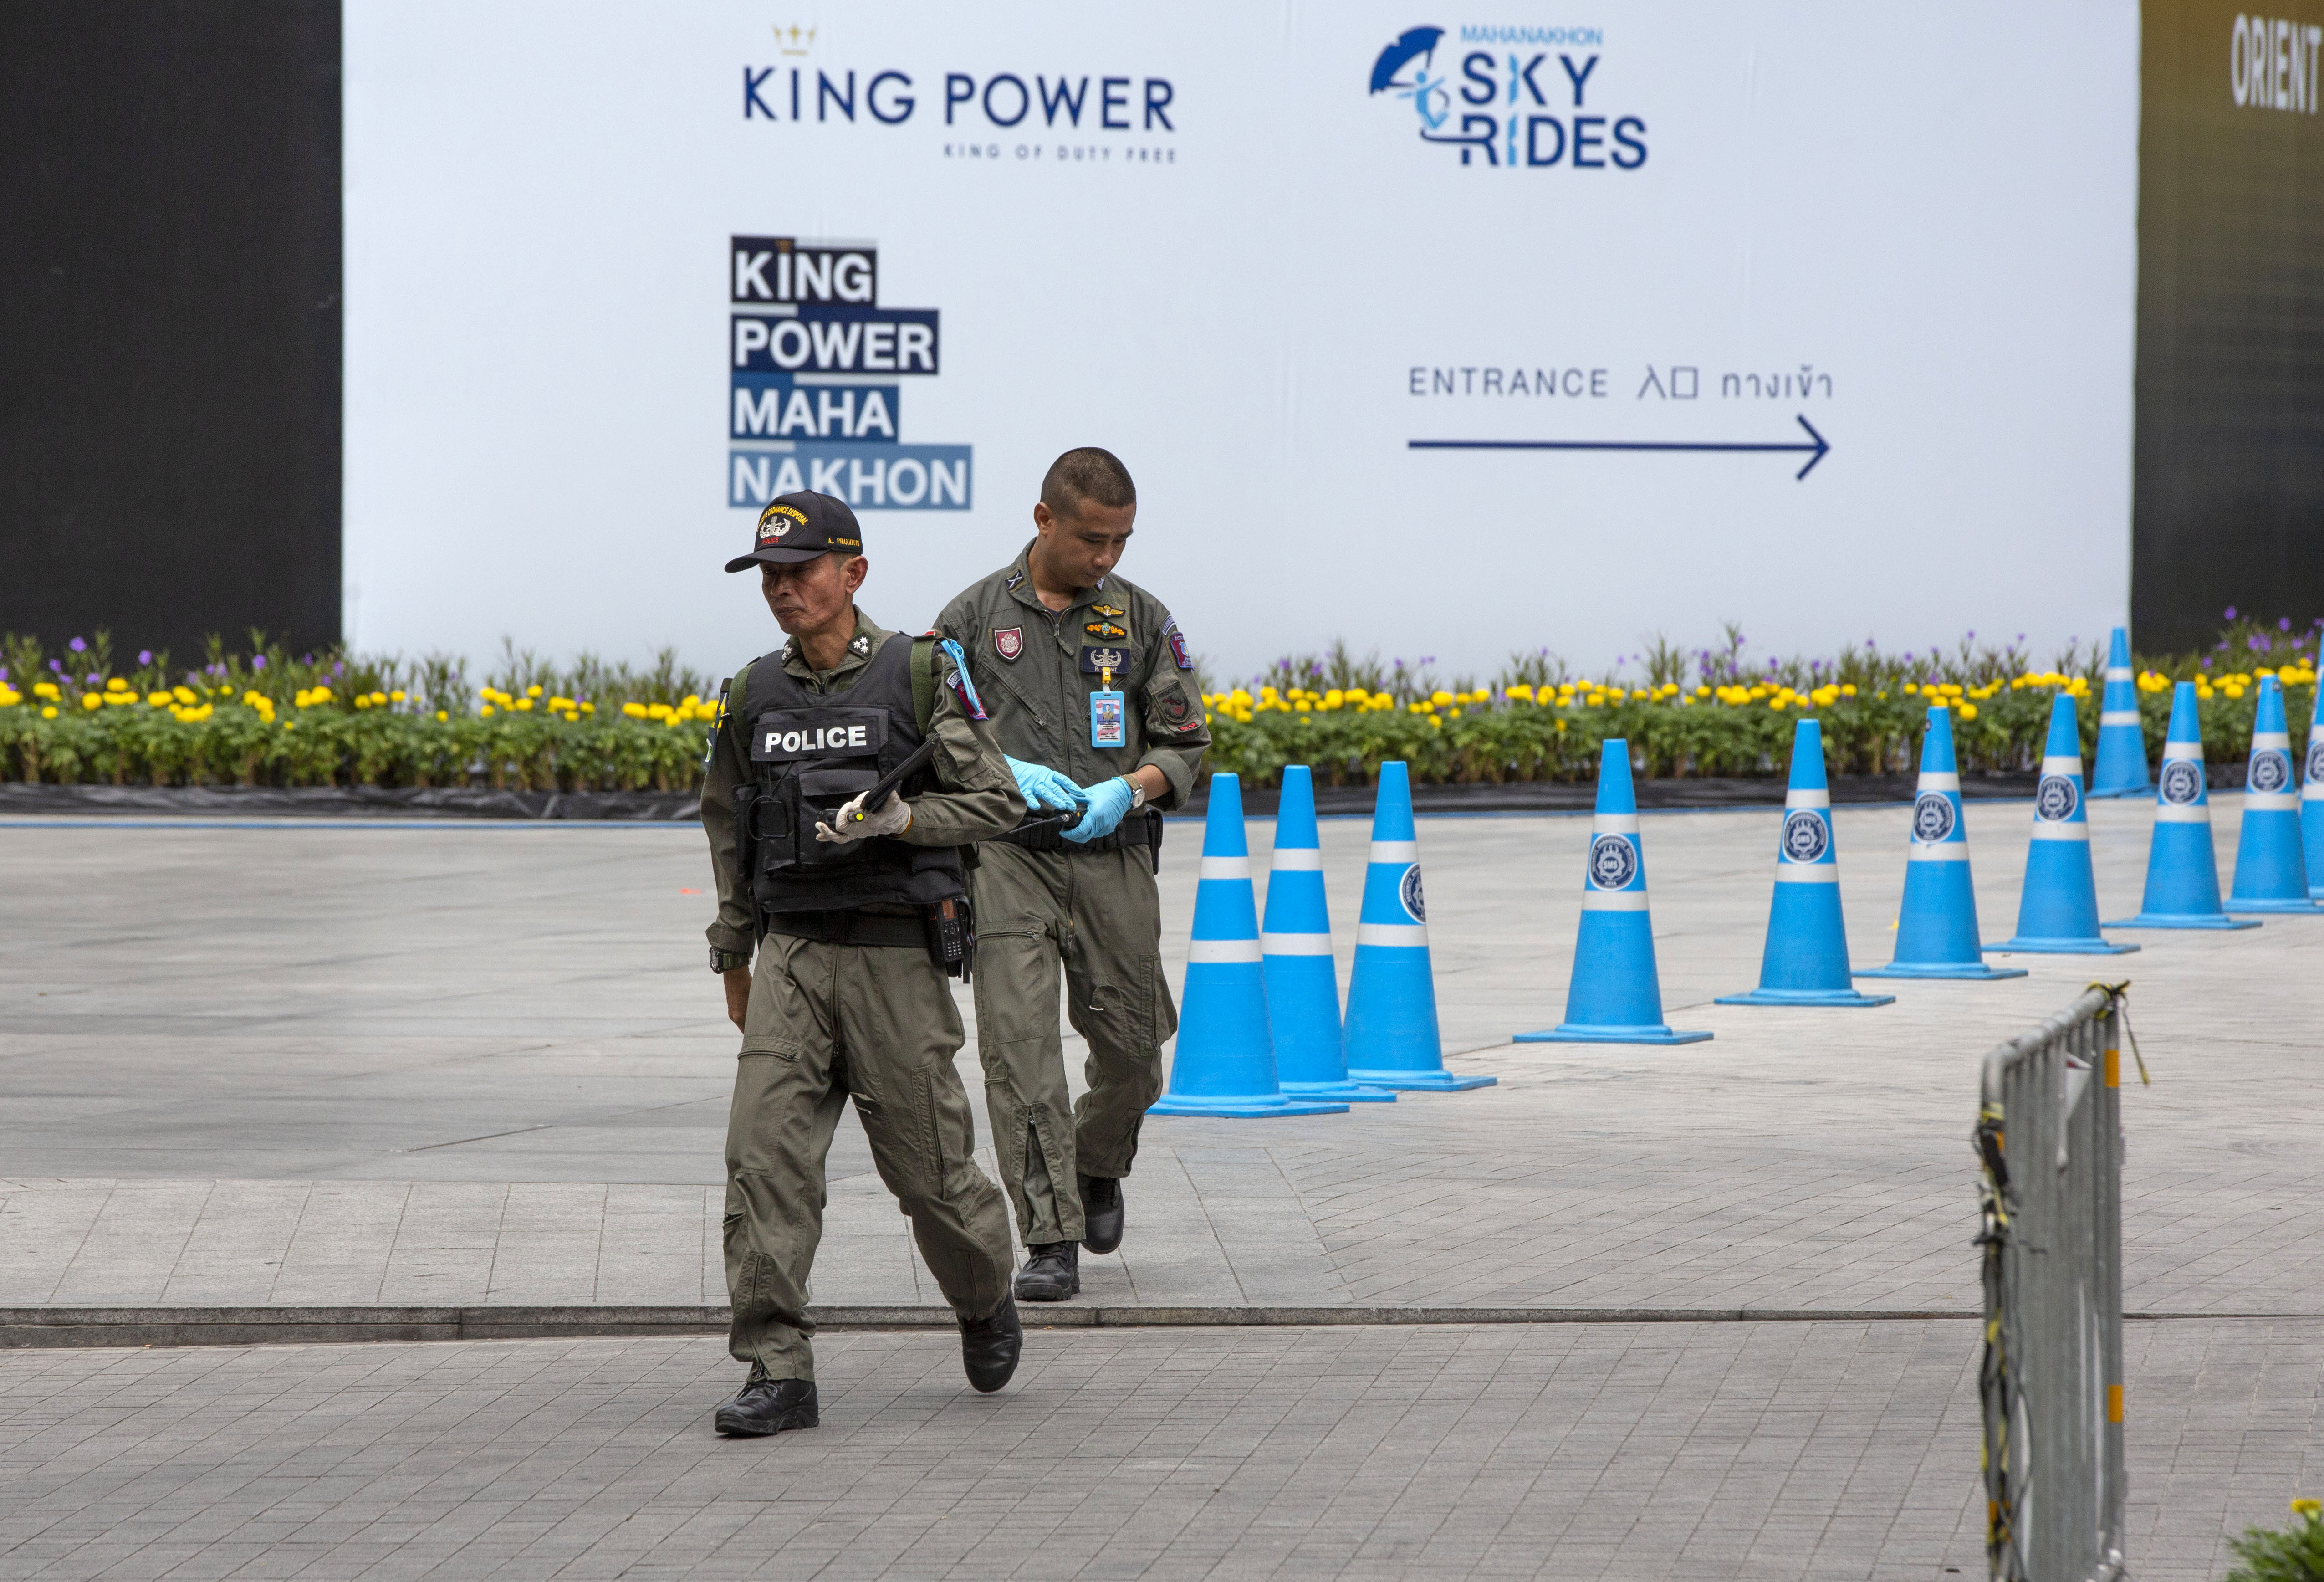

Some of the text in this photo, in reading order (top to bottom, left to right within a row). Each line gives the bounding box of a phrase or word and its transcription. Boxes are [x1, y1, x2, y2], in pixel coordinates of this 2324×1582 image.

[1460, 25, 1604, 45] MAHANAKHON
[1460, 50, 1600, 107] SKY
[2232, 12, 2323, 114] ORIENT
[743, 65, 1177, 132] KING POWER
[944, 143, 1177, 164] KING OF DUTY FREE
[1460, 113, 1648, 170] RIDES
[734, 250, 873, 302] KING
[734, 319, 935, 370] POWER
[1408, 367, 1608, 398] ENTRANCE
[1722, 364, 1834, 399] ทางเข้า
[734, 388, 895, 437] MAHA
[733, 456, 967, 506] NAKHON
[768, 506, 789, 516] ORDNANCE
[787, 508, 808, 526] DISPOSAL
[761, 537, 779, 545] POLICE
[764, 725, 867, 753] POLICE
